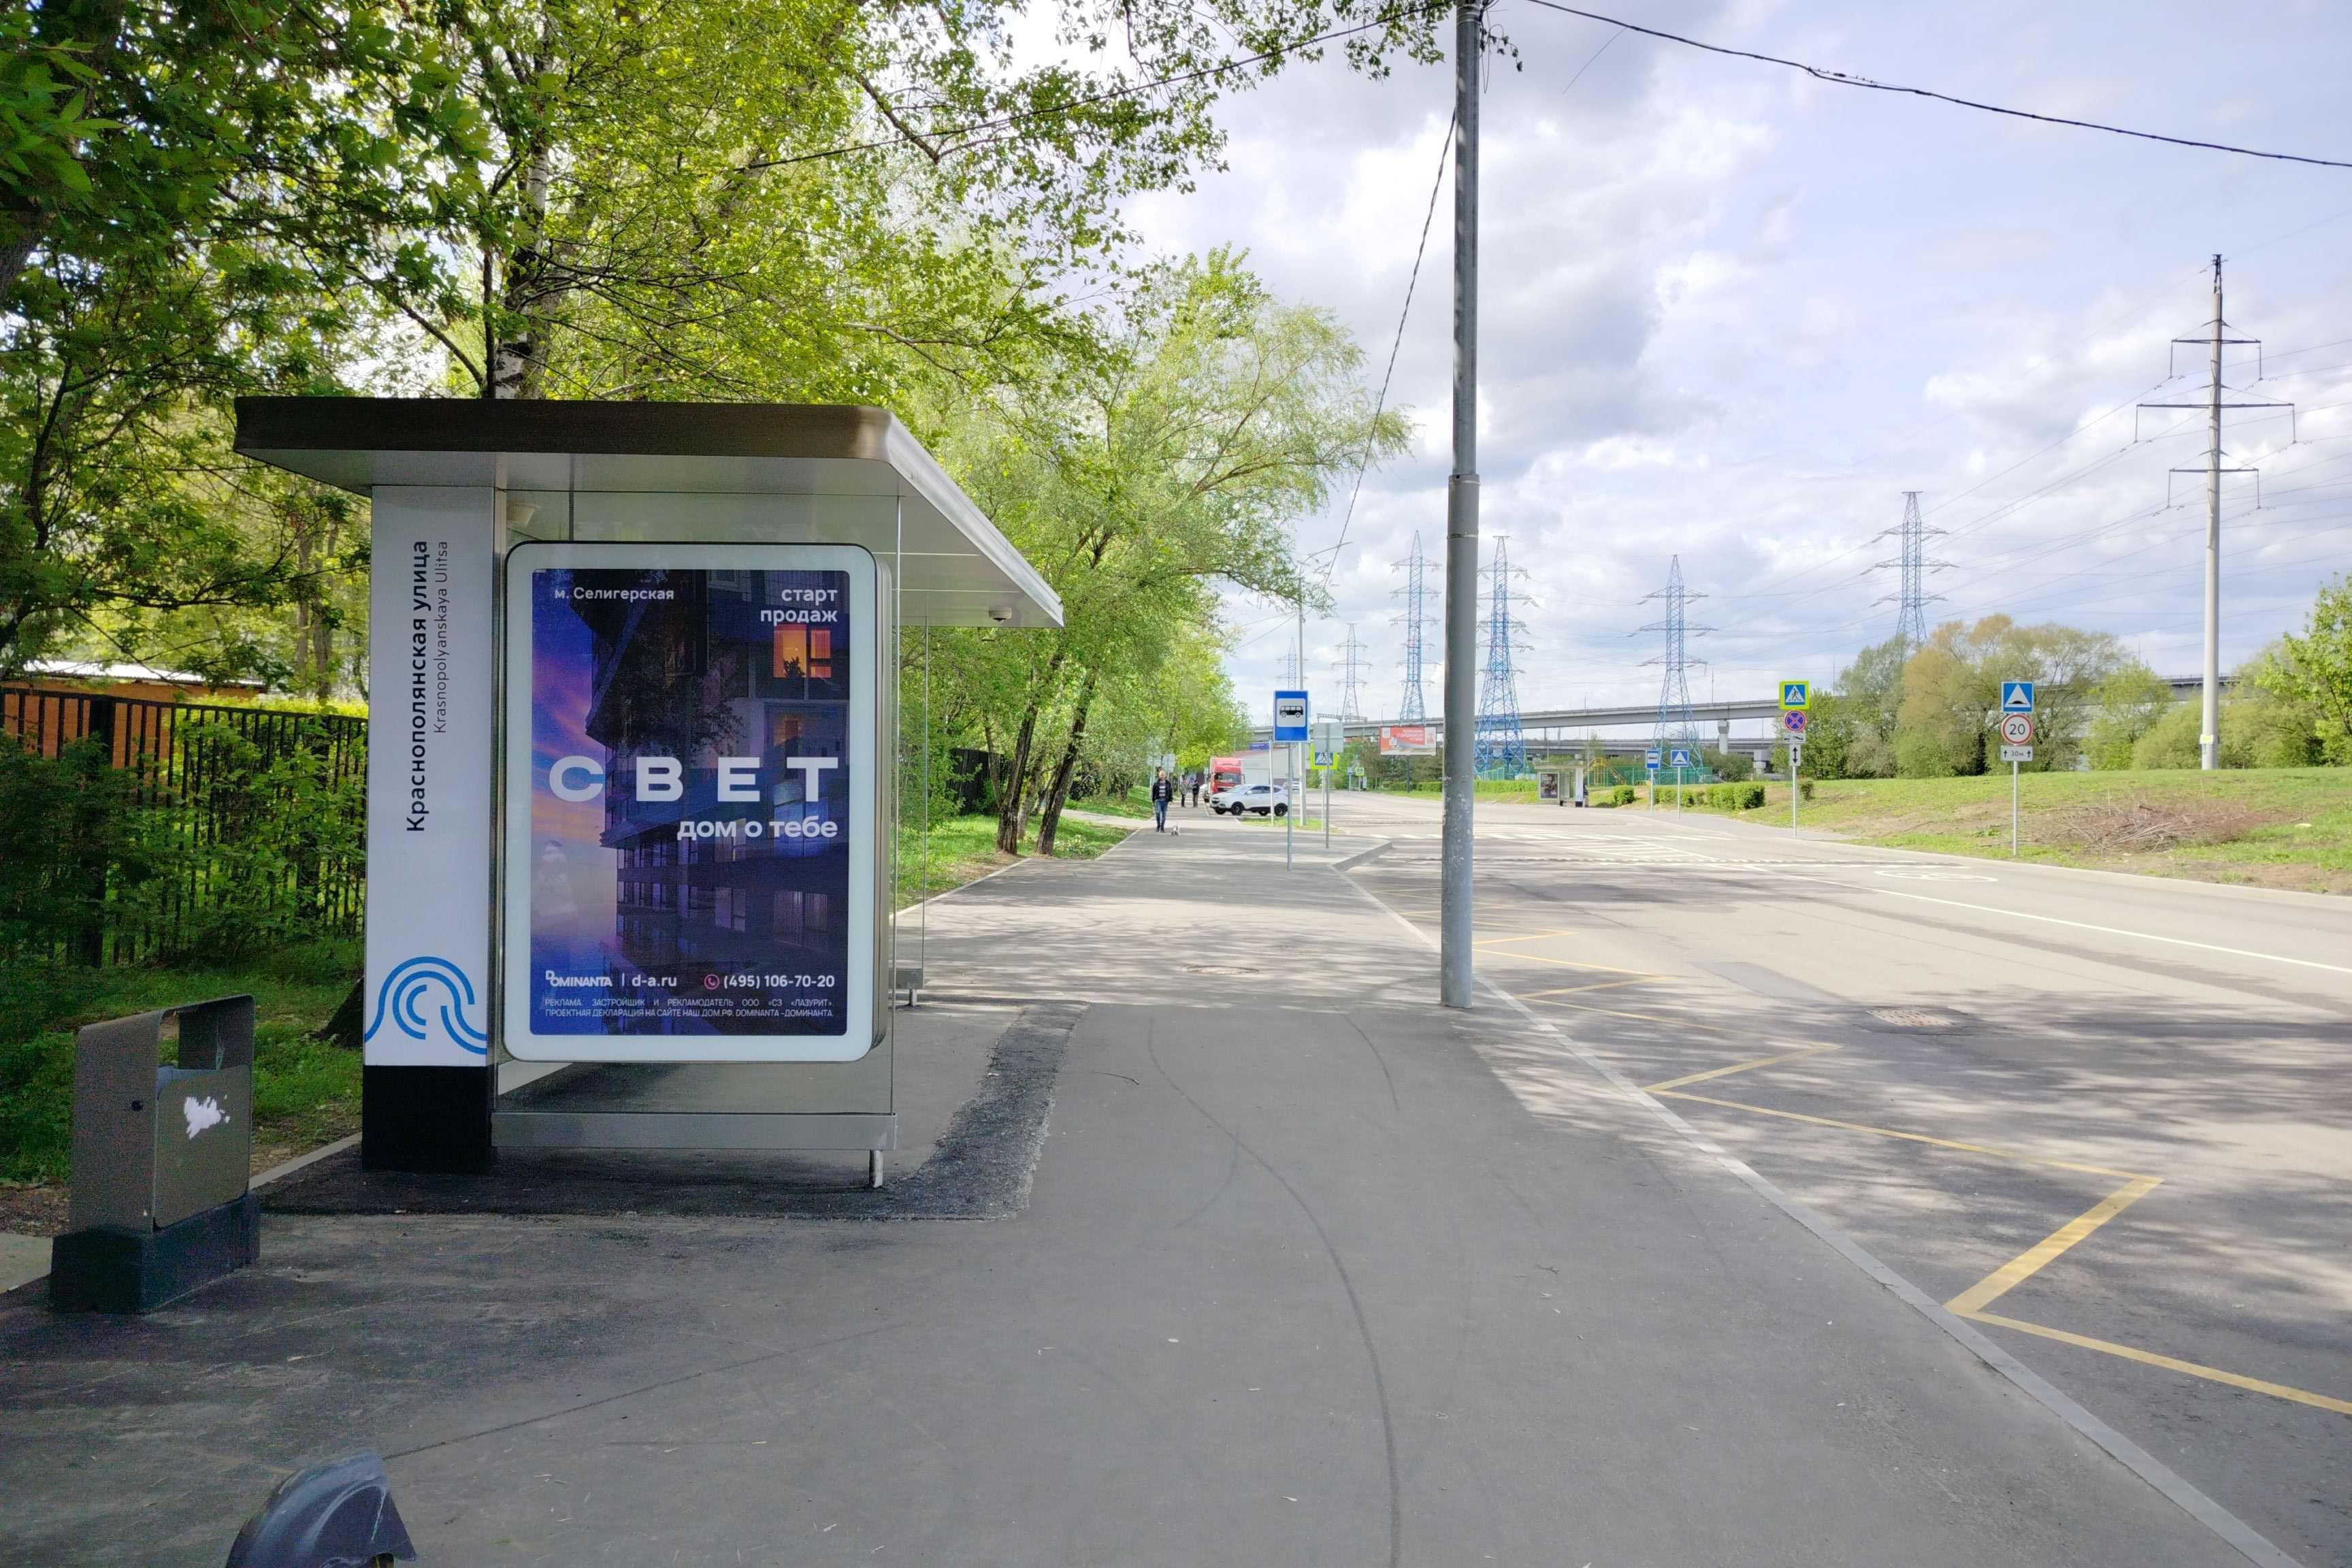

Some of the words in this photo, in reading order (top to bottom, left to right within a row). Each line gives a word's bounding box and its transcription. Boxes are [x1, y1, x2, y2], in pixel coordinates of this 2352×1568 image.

[434, 541, 448, 583] Ulitsa
[412, 541, 431, 612] улица
[554, 589, 569, 600] м.
[574, 587, 674, 602] Селигерская
[781, 589, 838, 606] старт
[760, 609, 838, 626] продаж
[434, 587, 449, 733] Krasnopolyanskaya
[406, 619, 429, 832] Краснополянская
[2010, 723, 2025, 735] 20
[549, 755, 838, 802] СВЕТ
[677, 821, 736, 840] дом
[745, 821, 763, 838] о
[769, 816, 838, 838] тебе
[545, 970, 612, 987] DOMINANTA
[632, 974, 677, 987] d-a.ru
[723, 975, 761, 989] (495)
[764, 975, 835, 987] 106-70-20
[592, 996, 645, 1007] ЗАСТРОЙЩИК
[653, 998, 659, 1007] И
[667, 998, 734, 1007] РЕКЛАМОДАТЕЛЬ
[741, 998, 760, 1007] ООО
[545, 1009, 591, 1017] ПРОЕКТНАЯ
[592, 1009, 644, 1017] ДЕКЛАРАЦИЯ
[645, 1009, 656, 1017] НА
[656, 1007, 681, 1017] САЙТЕ
